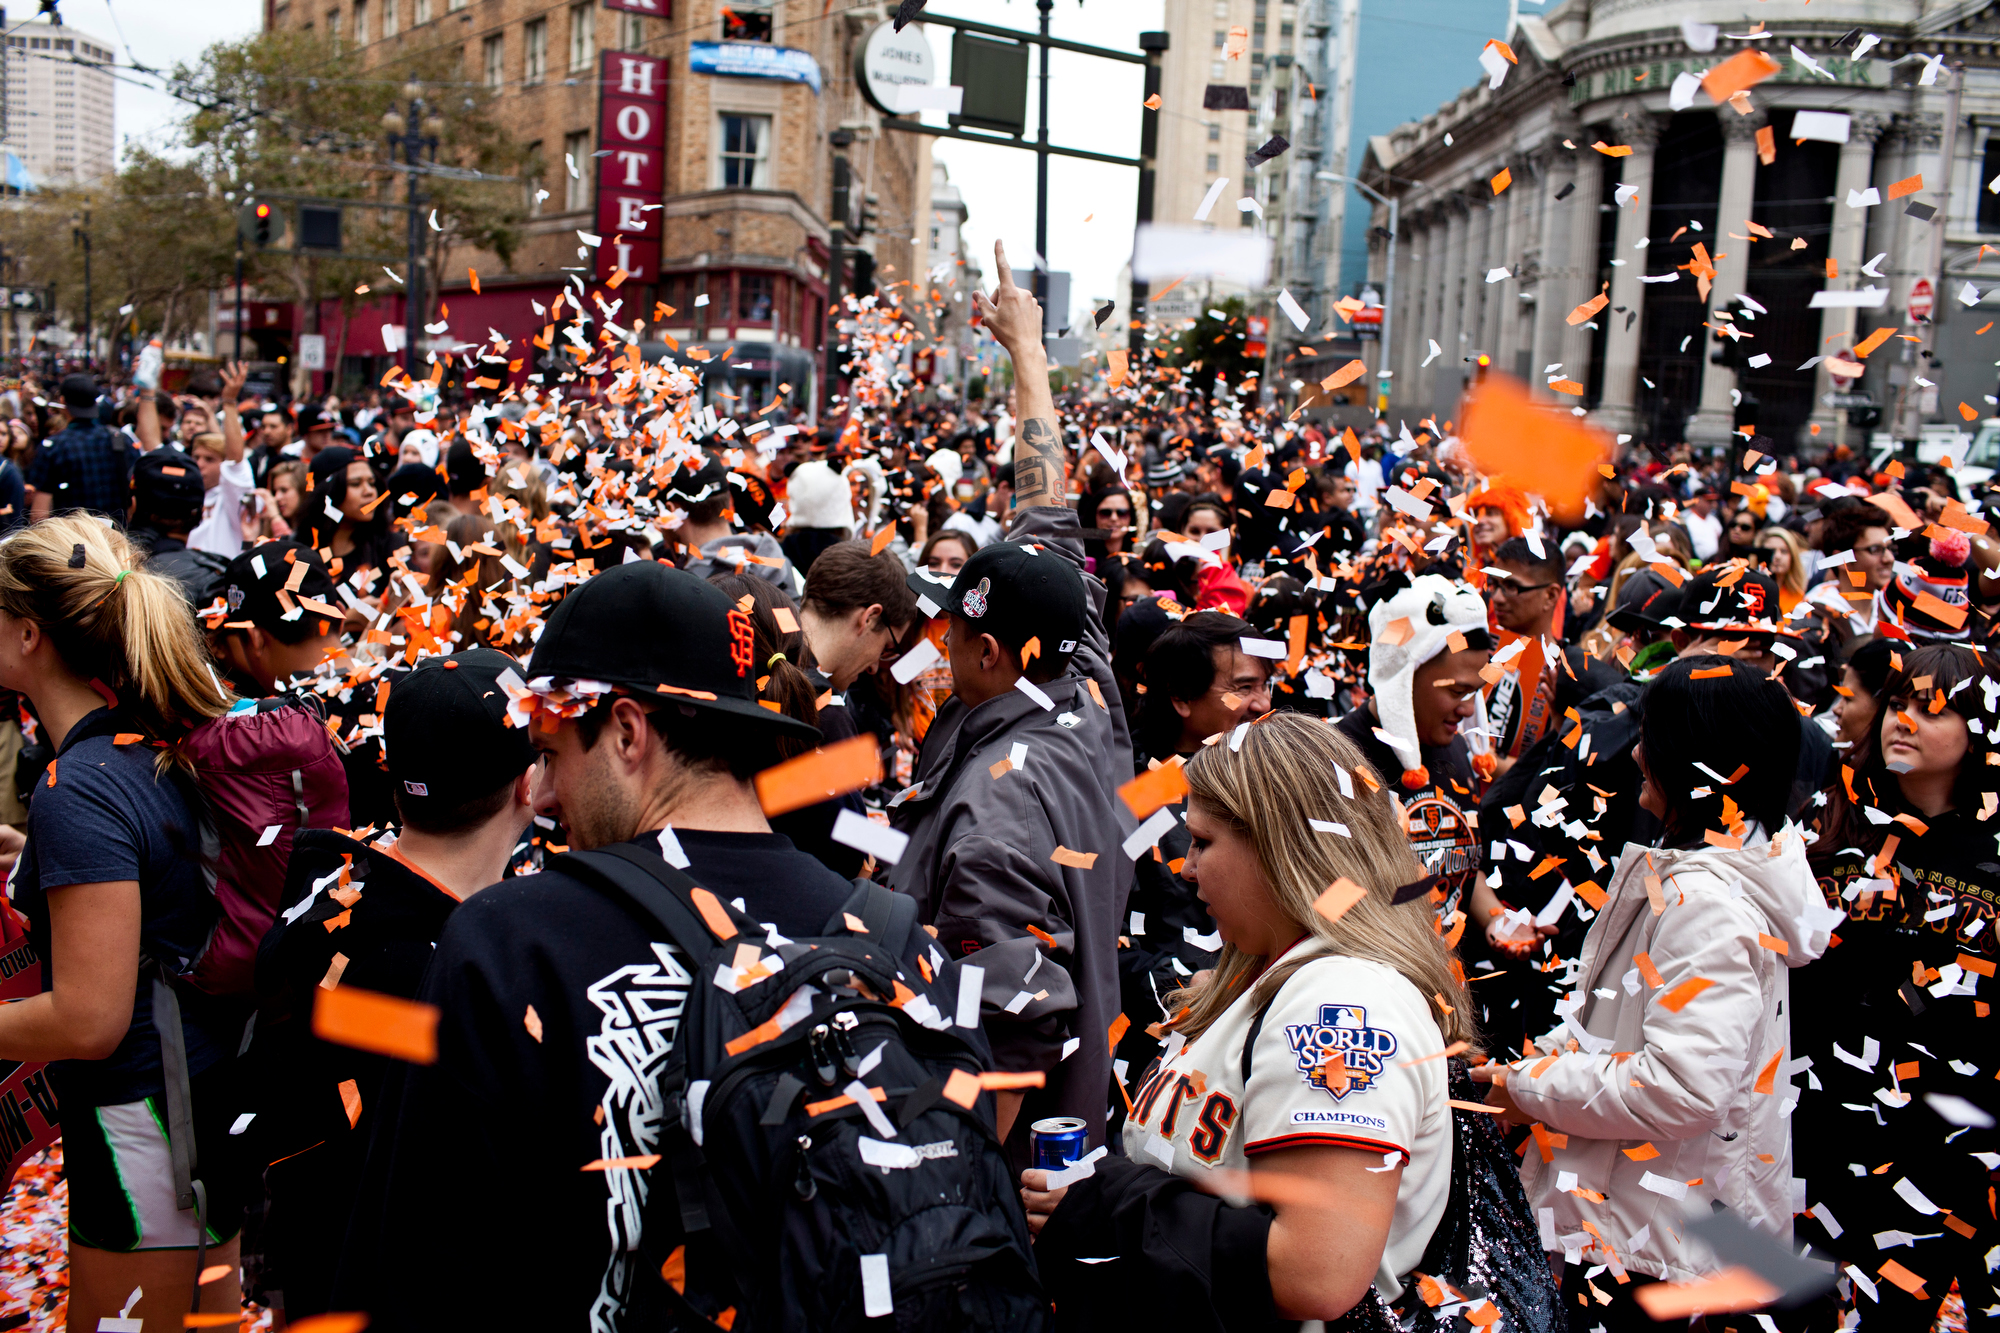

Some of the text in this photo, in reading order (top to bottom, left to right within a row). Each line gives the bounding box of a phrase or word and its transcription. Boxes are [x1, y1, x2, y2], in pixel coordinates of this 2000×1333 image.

[881, 46, 922, 64] JONES
[615, 58, 656, 278] HOTEL
[1, 943, 40, 980] ORLD
[1287, 1025, 1396, 1055] WORLD
[1300, 1045, 1383, 1073] SEIES
[1293, 1112, 1386, 1129] CHAMPIONS
